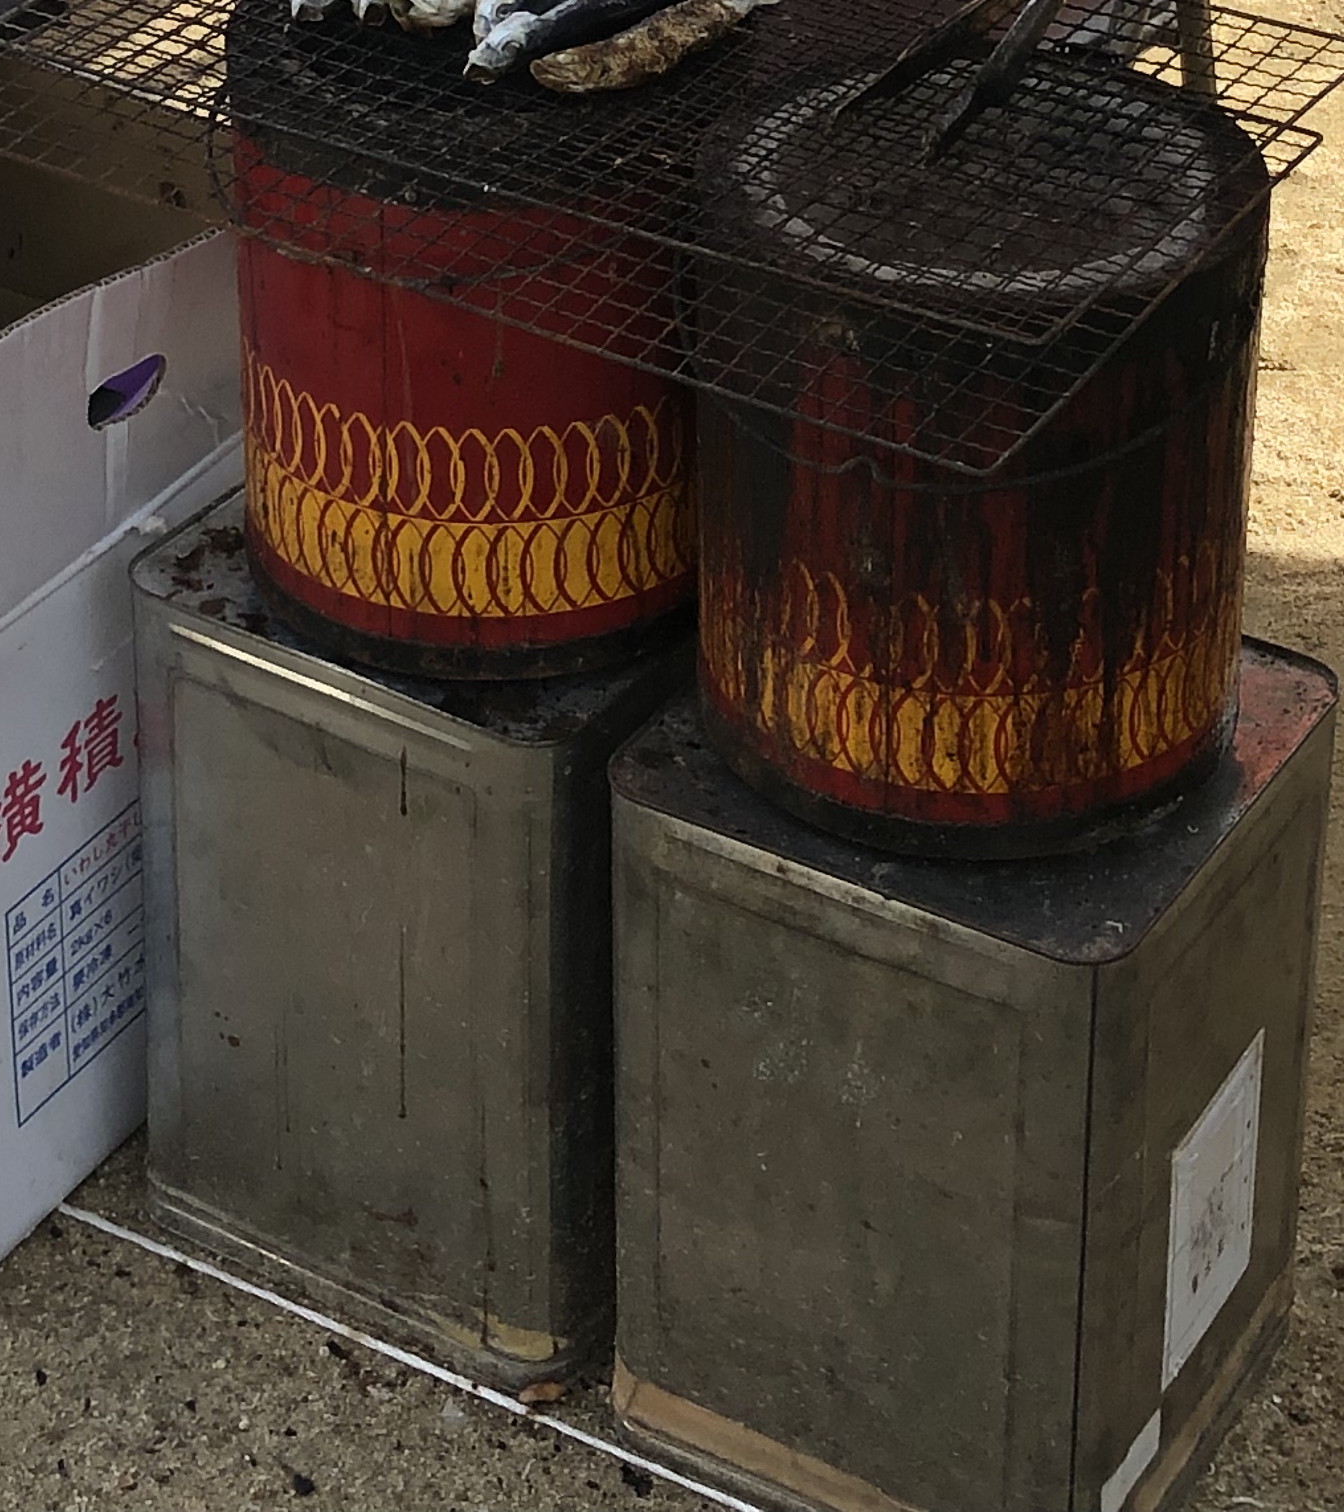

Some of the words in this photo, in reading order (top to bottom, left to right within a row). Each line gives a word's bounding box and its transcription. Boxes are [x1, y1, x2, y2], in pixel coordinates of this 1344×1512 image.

[17, 956, 58, 1006] 内容量
[21, 1031, 62, 1079] 製造者
